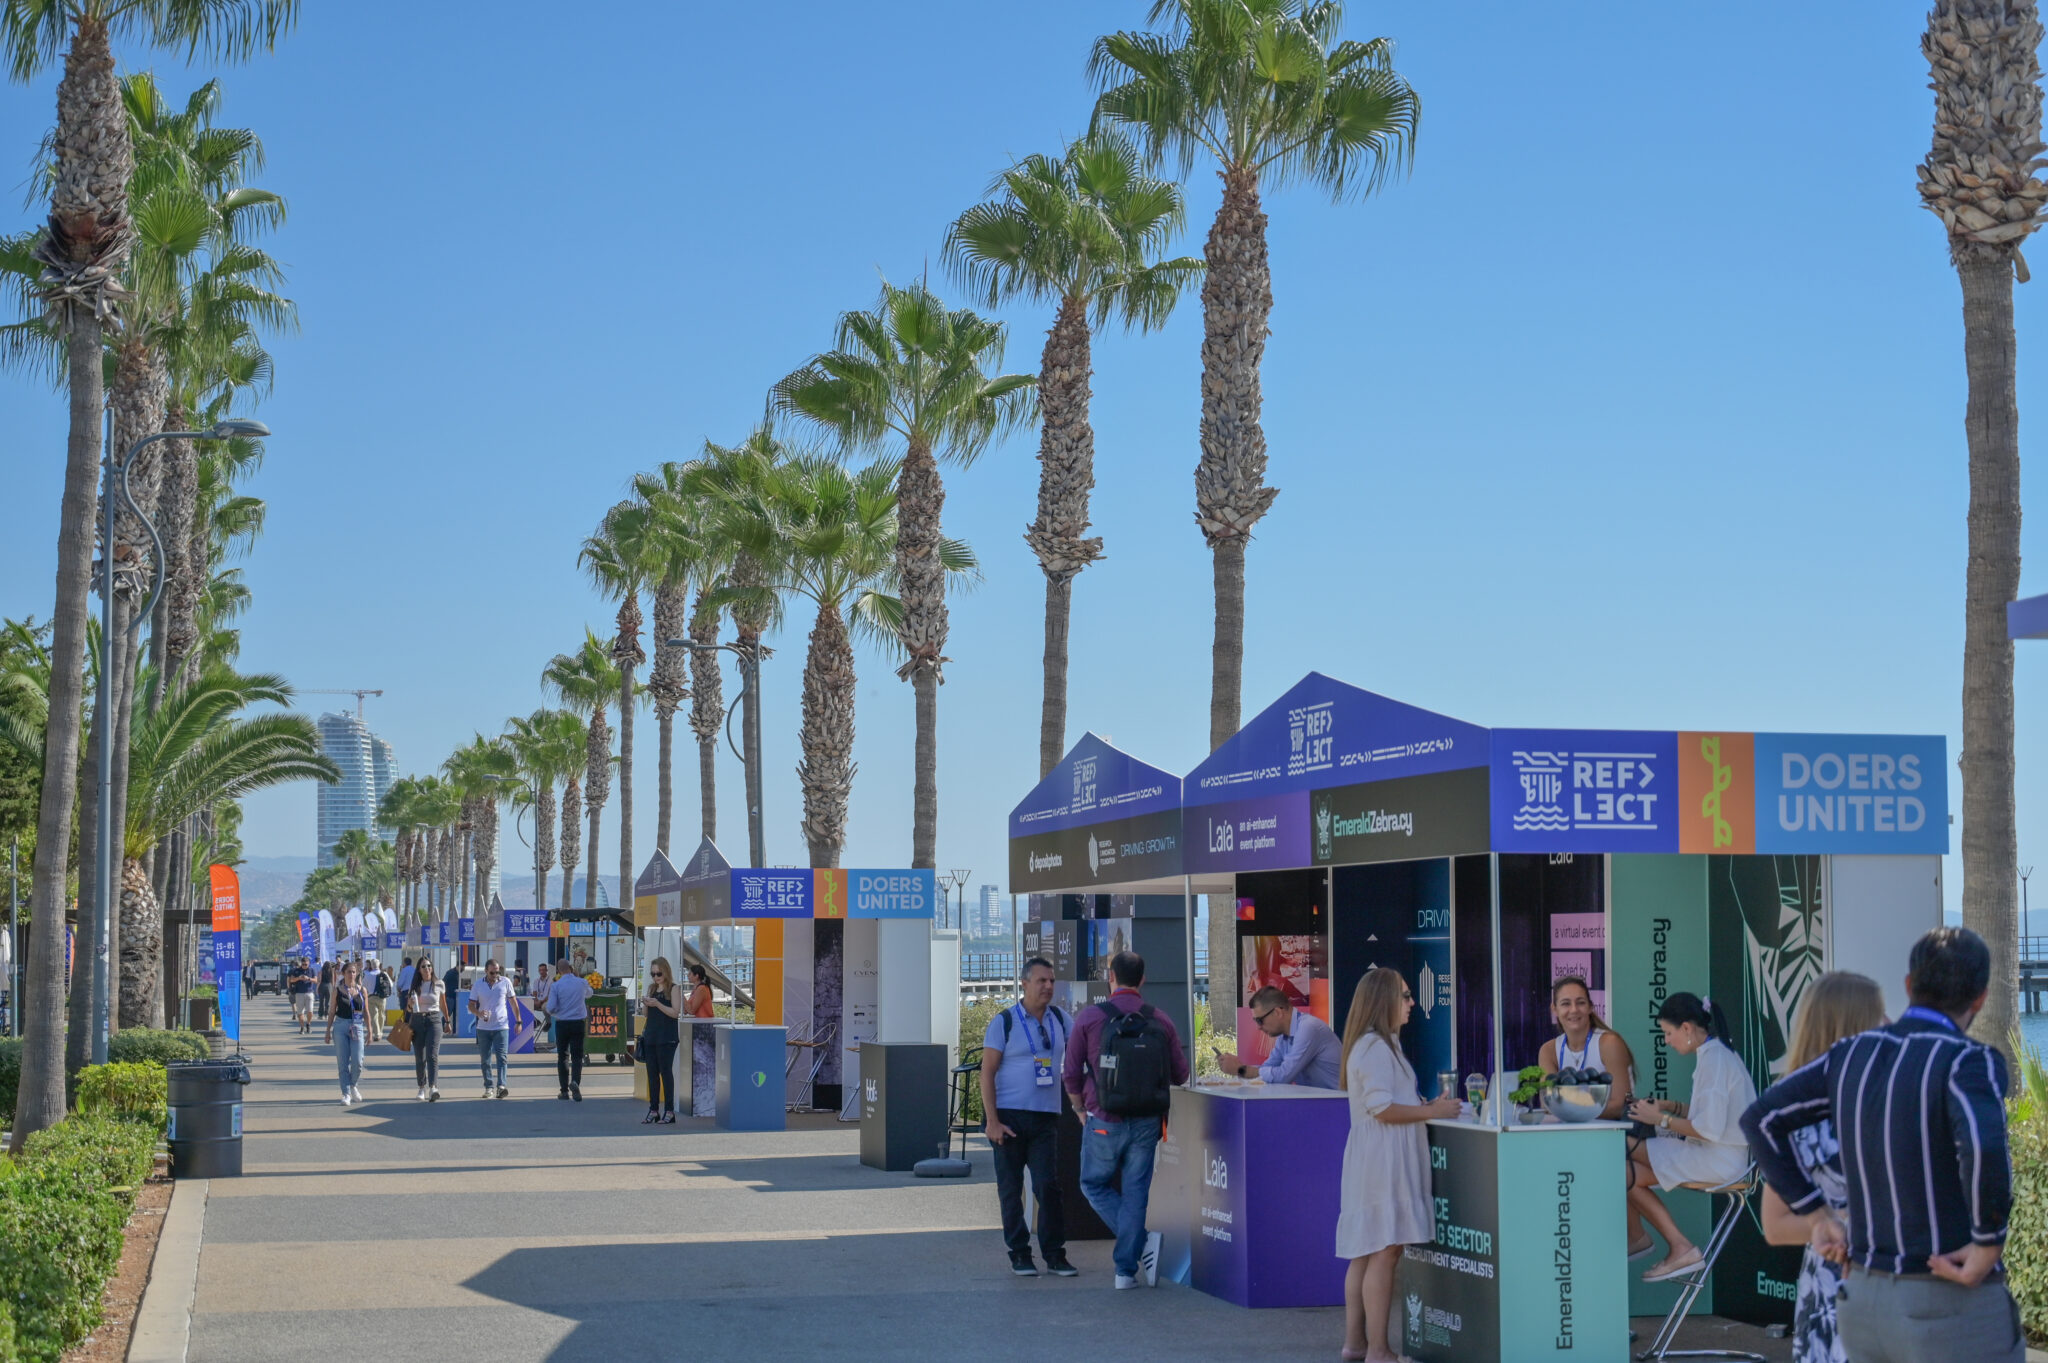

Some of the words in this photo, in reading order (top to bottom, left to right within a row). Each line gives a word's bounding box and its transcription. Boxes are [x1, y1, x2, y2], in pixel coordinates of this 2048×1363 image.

[1782, 753, 1922, 790] DOERS
[1333, 809, 1413, 837] EmeraldZebra.cy
[1778, 795, 1926, 832] UNITED
[1240, 822, 1245, 832] an
[1246, 815, 1277, 831] ai-enhanced
[1209, 817, 1233, 853] Laia
[1240, 838, 1253, 850] event
[1254, 835, 1275, 852] platform
[1120, 841, 1144, 857] DRIVING
[1145, 836, 1176, 854] GROWTH
[859, 876, 923, 893] DOERS
[857, 894, 925, 910] UNITED
[1555, 928, 1559, 938] a
[1560, 923, 1580, 938] virtual
[1582, 925, 1601, 938] event
[1555, 962, 1578, 976] backed
[590, 1007, 611, 1016] THE
[590, 1025, 611, 1034] BOX
[1430, 1146, 1447, 1170] CH
[1204, 1148, 1228, 1190] Laia
[1207, 1208, 1232, 1224] ai-enhanced
[1202, 1225, 1214, 1237] event
[1214, 1227, 1232, 1243] platform
[1447, 1225, 1492, 1256] SECTOR
[1404, 1246, 1450, 1269] RECRUITMENT
[1450, 1255, 1494, 1279] SPECIALISTS
[1554, 1170, 1575, 1350] EmeraldZebra.cy
